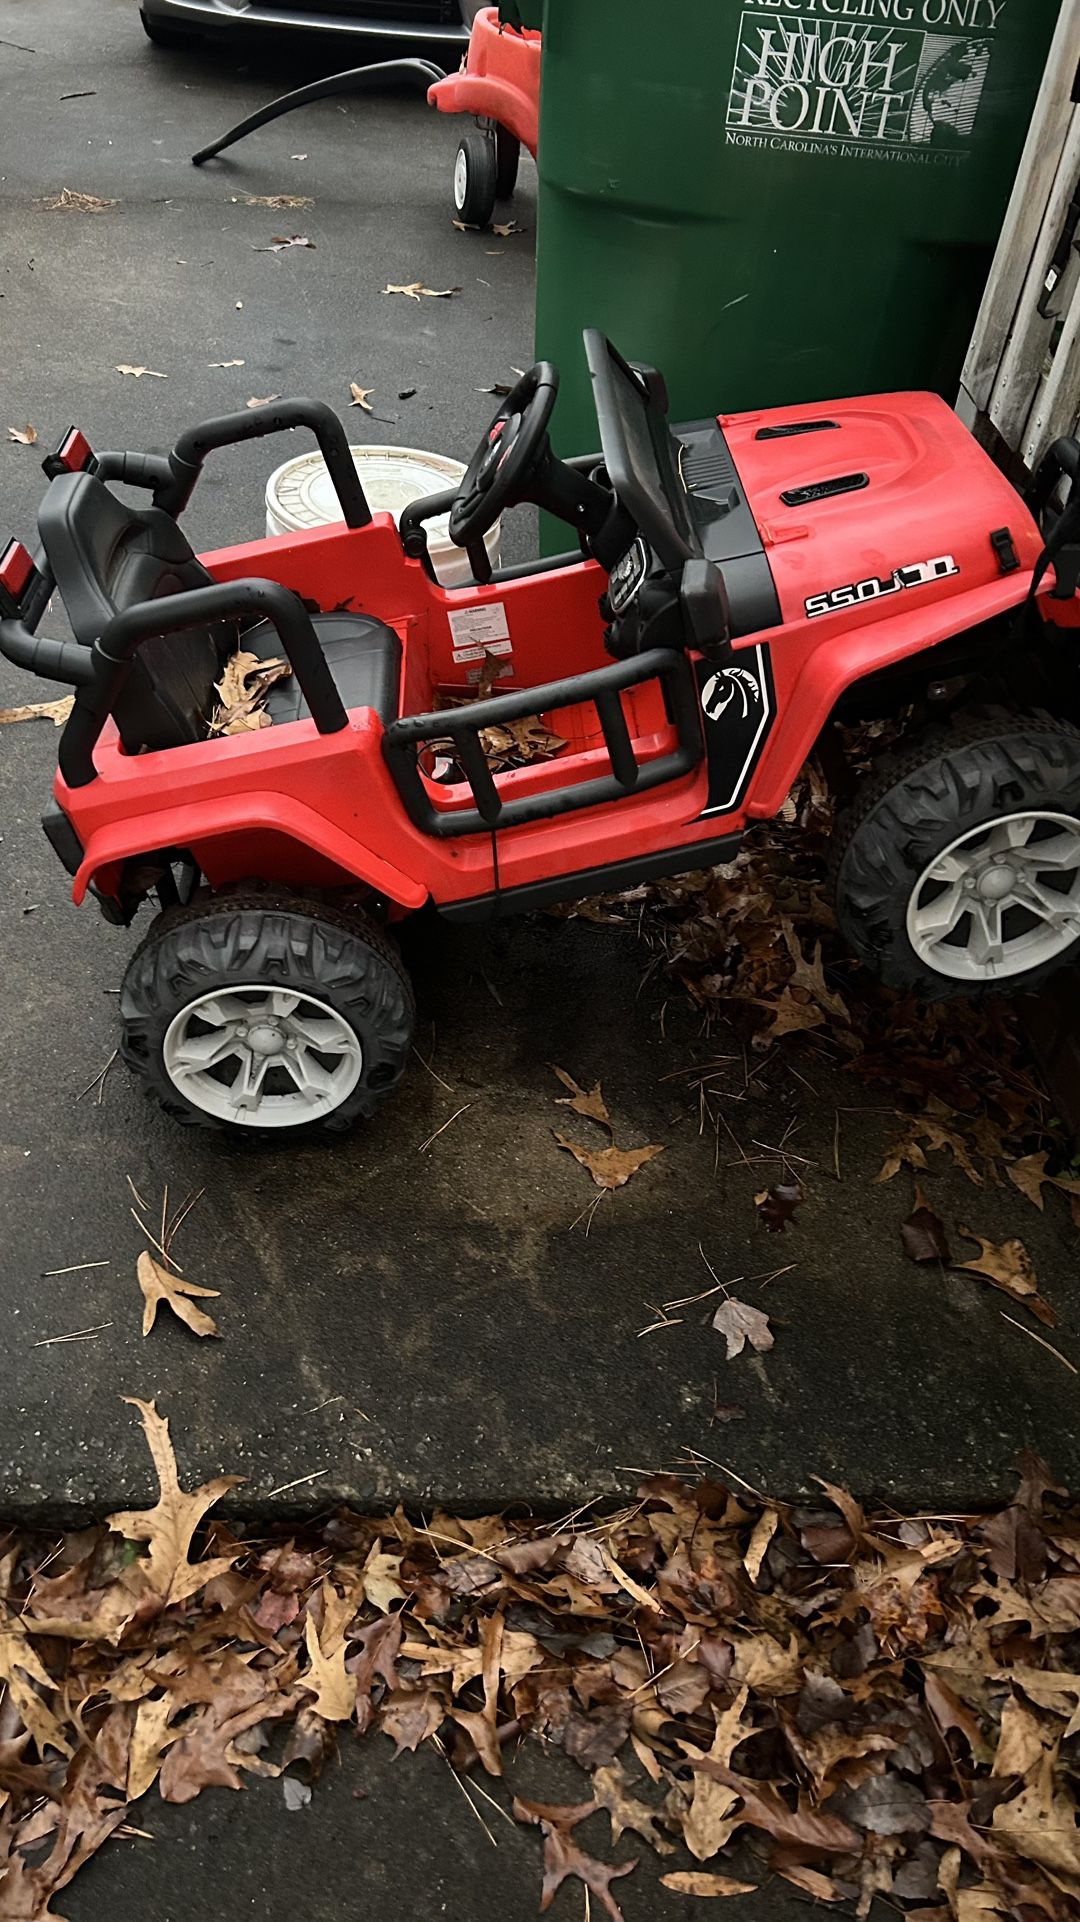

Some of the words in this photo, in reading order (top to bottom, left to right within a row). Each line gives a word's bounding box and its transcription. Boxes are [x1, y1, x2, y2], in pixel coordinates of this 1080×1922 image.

[744, 0, 914, 20] CLING
[922, 0, 1007, 29] ONLY
[754, 29, 903, 91] HIGH
[736, 78, 904, 139] POINT
[725, 131, 768, 149] NORTH
[770, 137, 838, 155] CAROLINA'S
[840, 144, 931, 164] INTERNATIONAL
